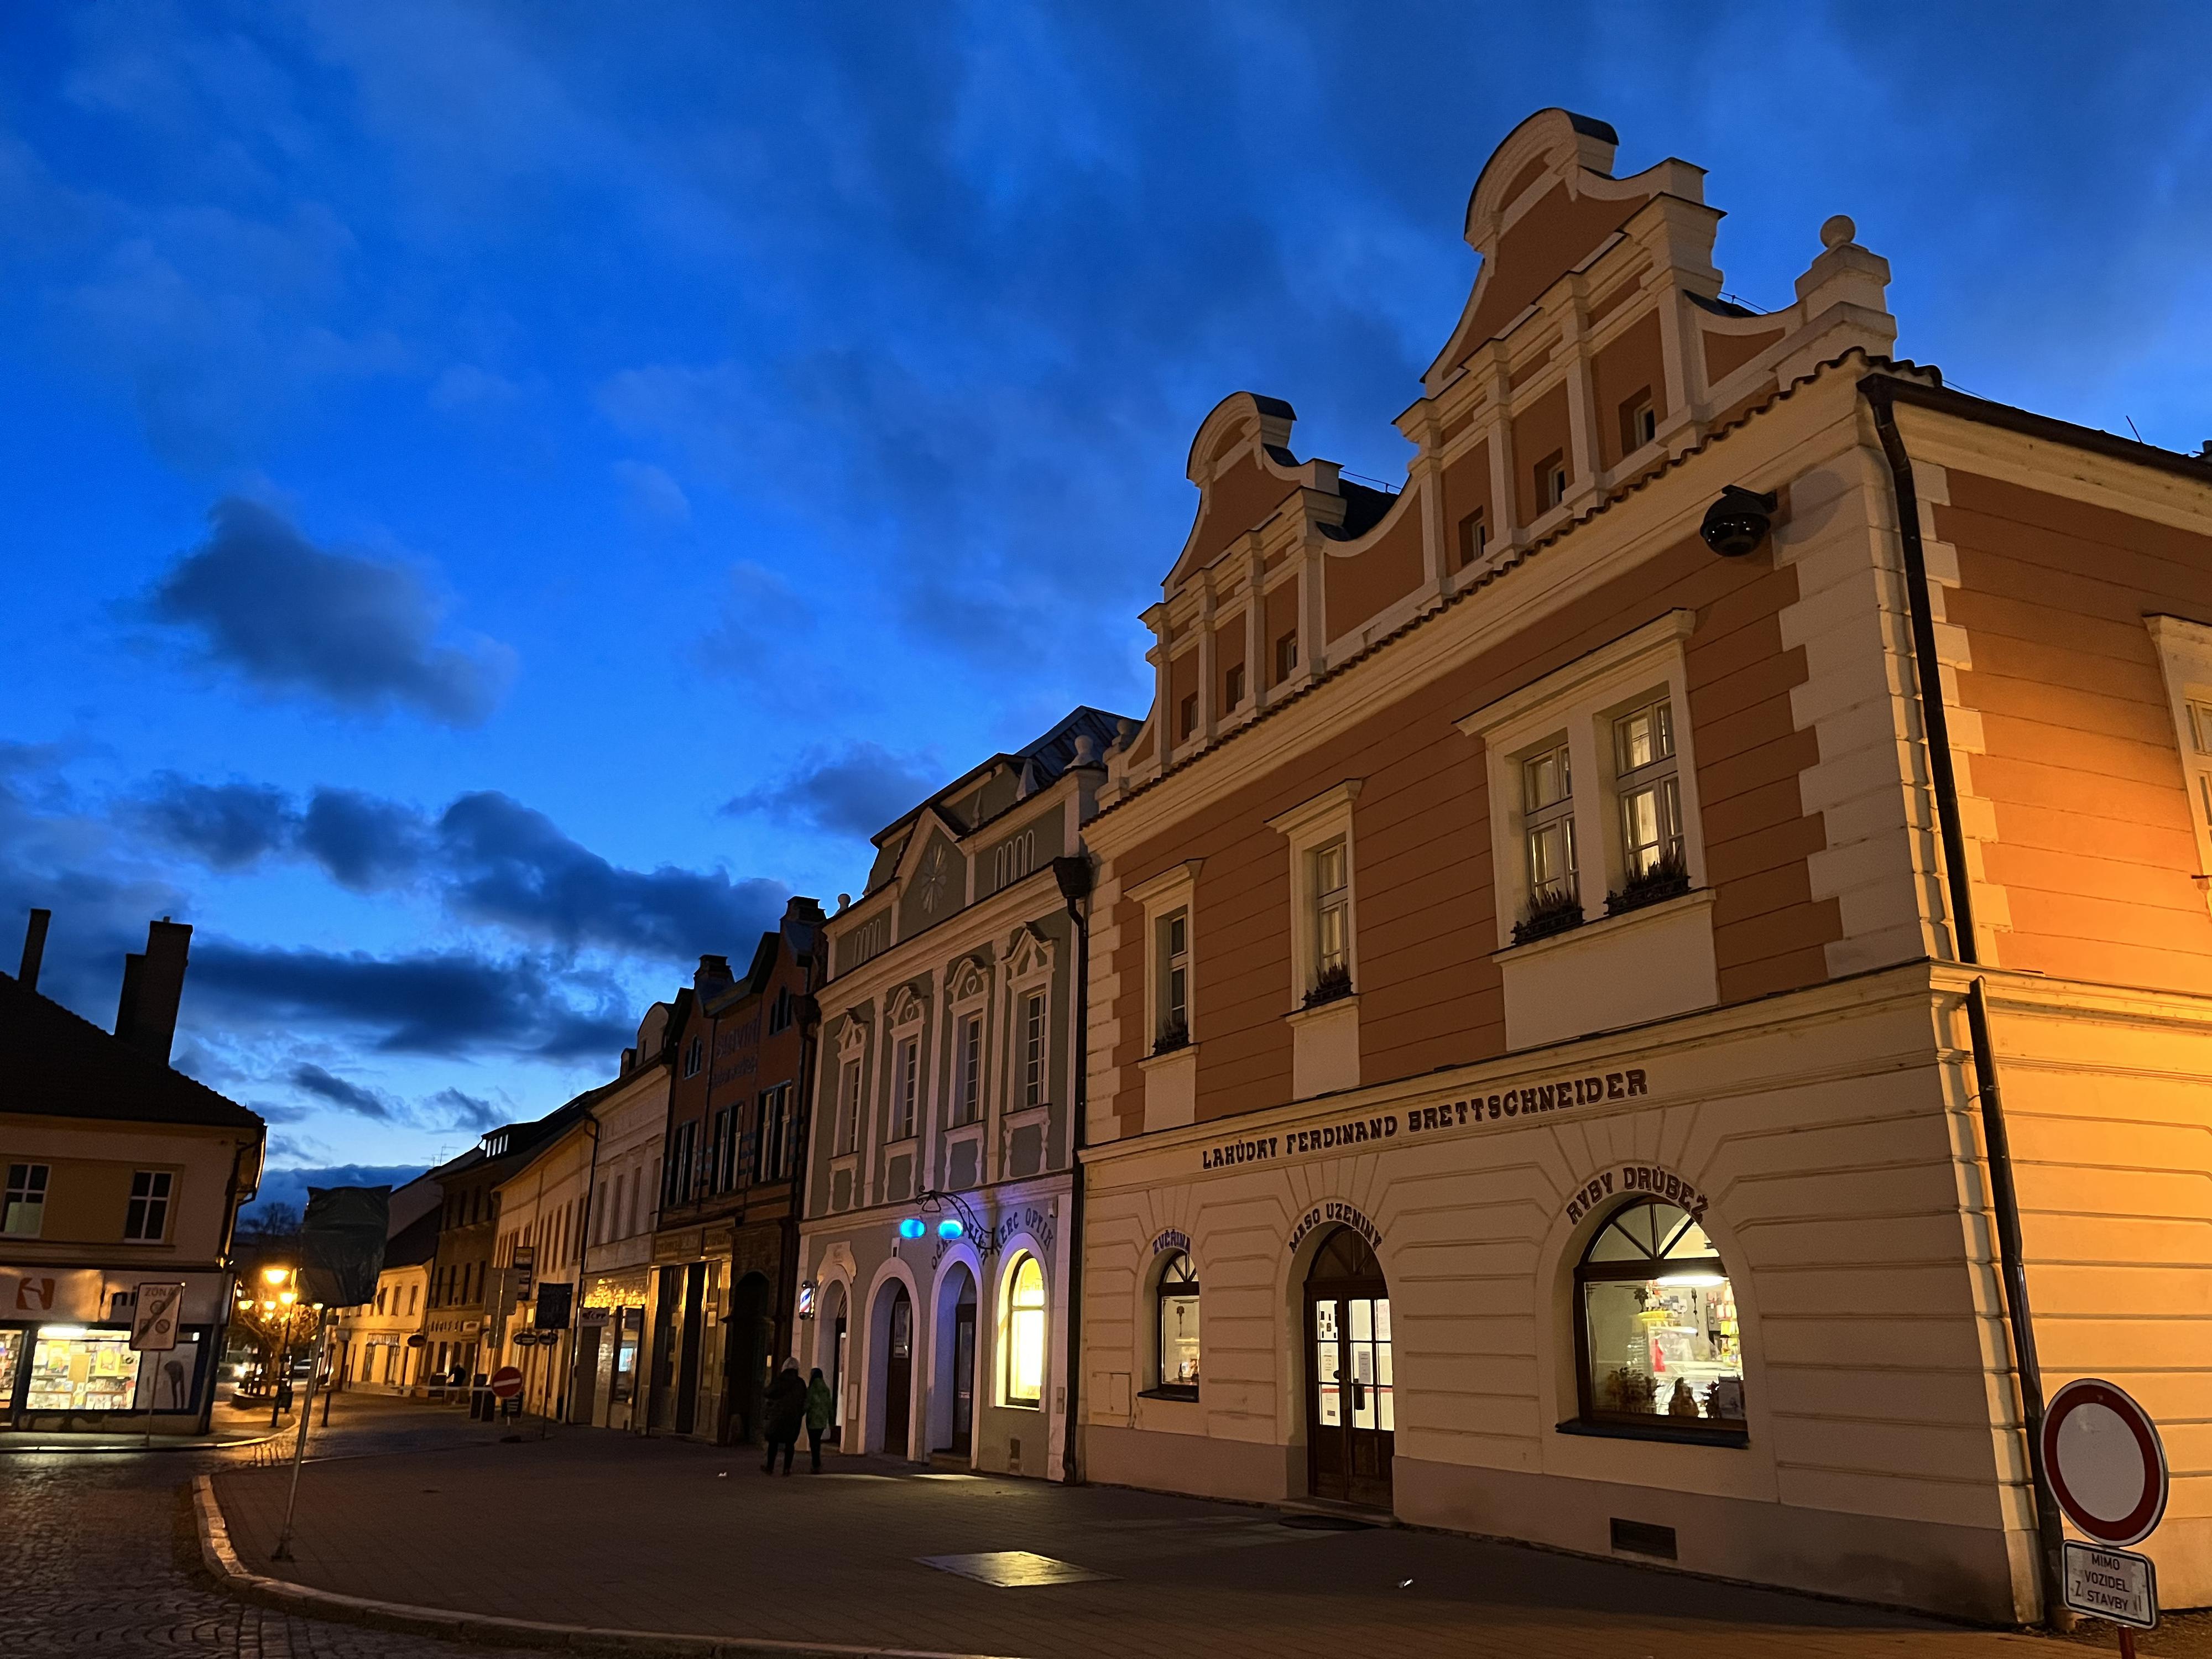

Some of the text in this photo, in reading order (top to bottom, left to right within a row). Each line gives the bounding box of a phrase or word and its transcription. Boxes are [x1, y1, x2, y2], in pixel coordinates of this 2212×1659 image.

[1286, 1116, 1398, 1155] FERDINAND
[1408, 1068, 1648, 1132] BRETTSCHNEIDER
[1566, 1172, 1613, 1225] RYBY
[1288, 1203, 1382, 1253] MASO UZENINY
[2092, 1553, 2120, 1571] MIMO
[2084, 1570, 2130, 1593] VOZIDEL
[2087, 1590, 2128, 1611] STAVBY
